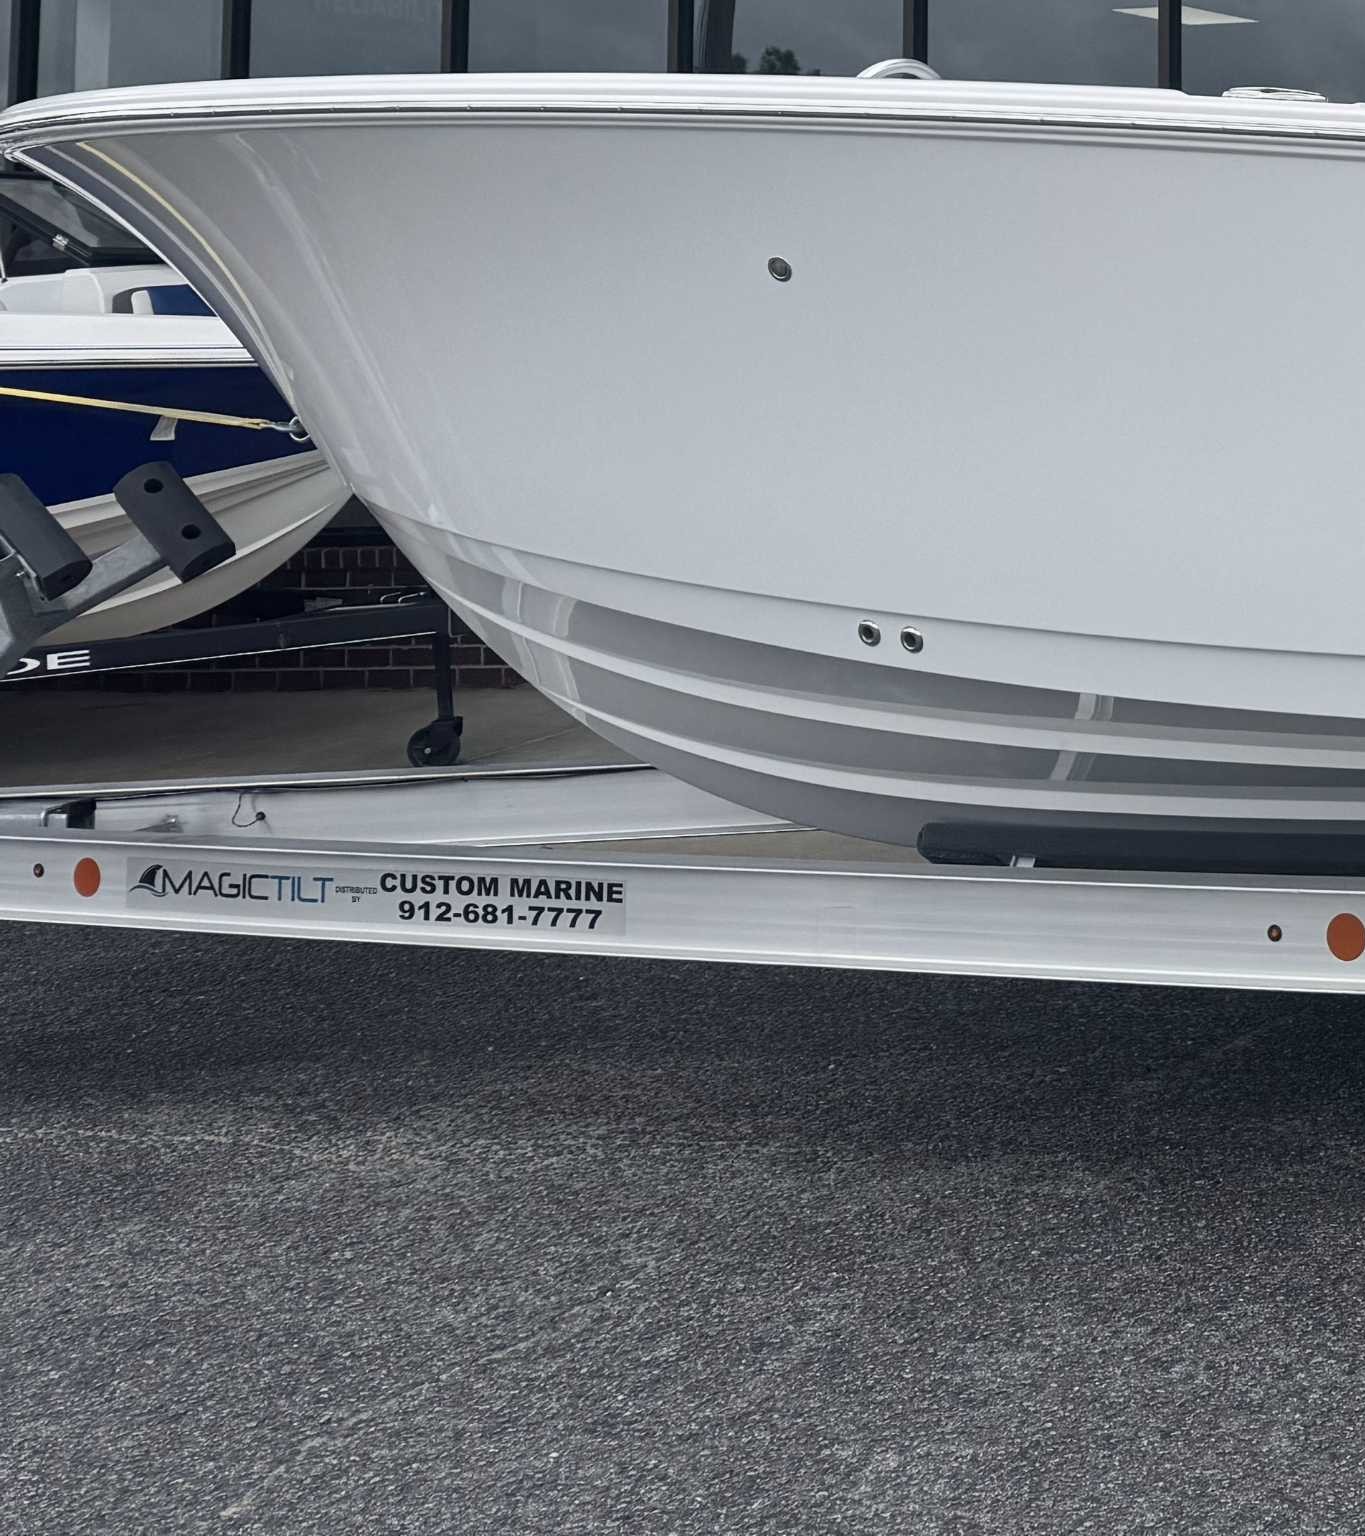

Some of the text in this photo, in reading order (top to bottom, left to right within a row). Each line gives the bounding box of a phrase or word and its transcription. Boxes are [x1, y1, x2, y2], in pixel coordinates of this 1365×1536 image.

[380, 872, 624, 903] CUSTOM MARINE
[398, 900, 603, 929] 912-681-7777
